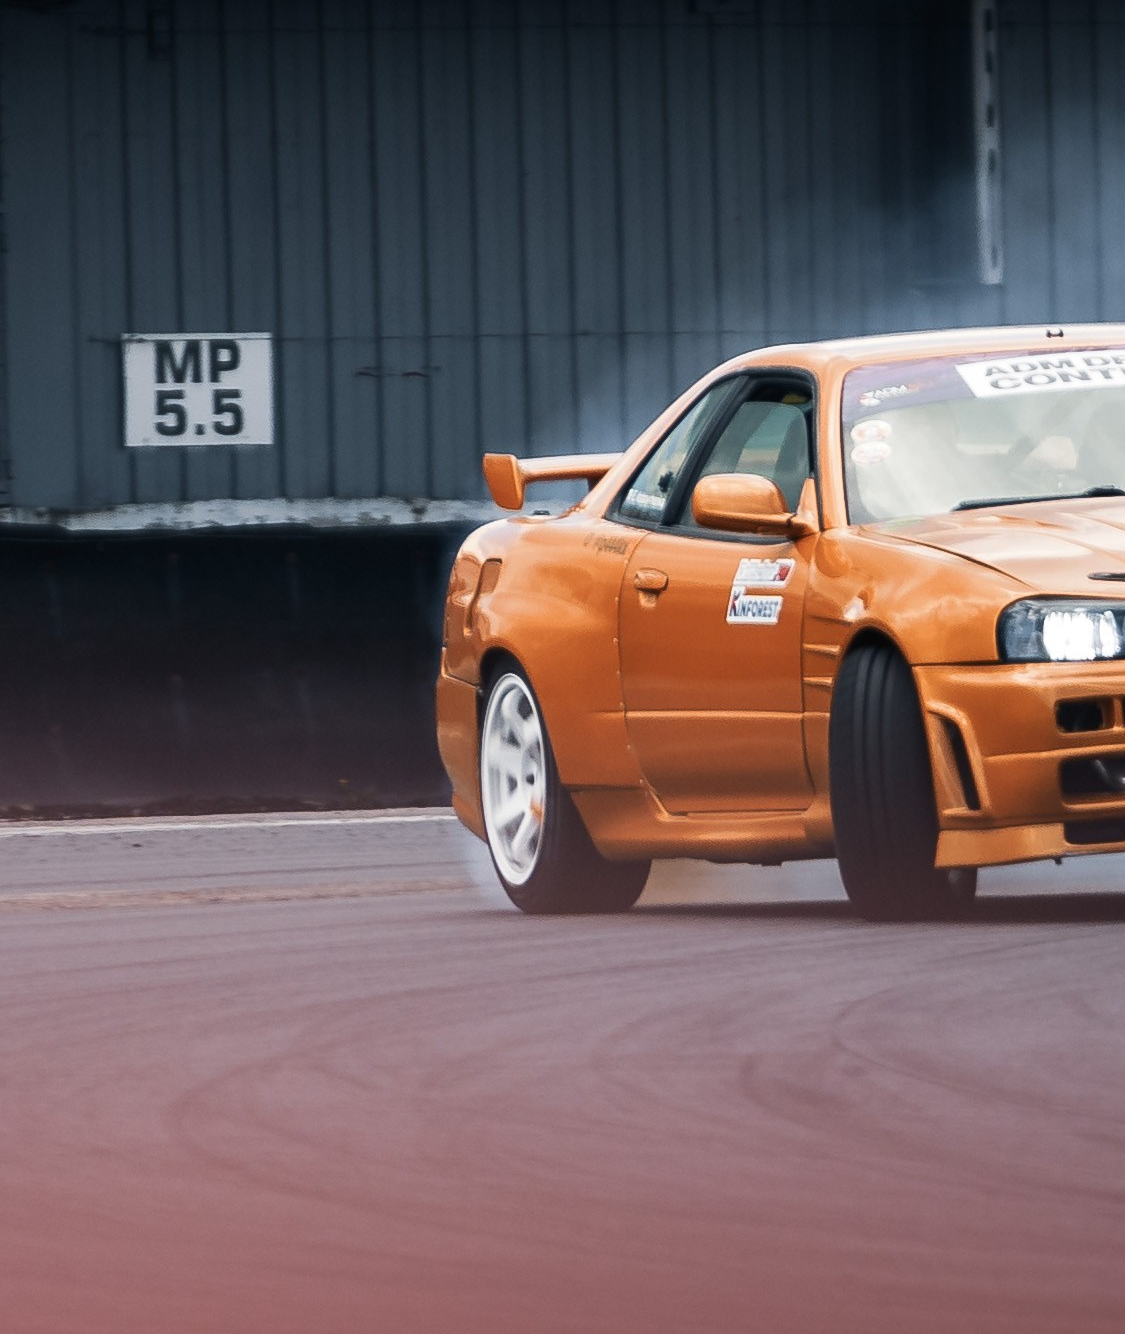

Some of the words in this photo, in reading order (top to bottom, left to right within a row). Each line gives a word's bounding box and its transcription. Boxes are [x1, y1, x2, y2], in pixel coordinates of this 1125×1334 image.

[154, 338, 241, 384] MP
[985, 358, 1076, 377] ADM
[154, 388, 244, 437] 5.5
